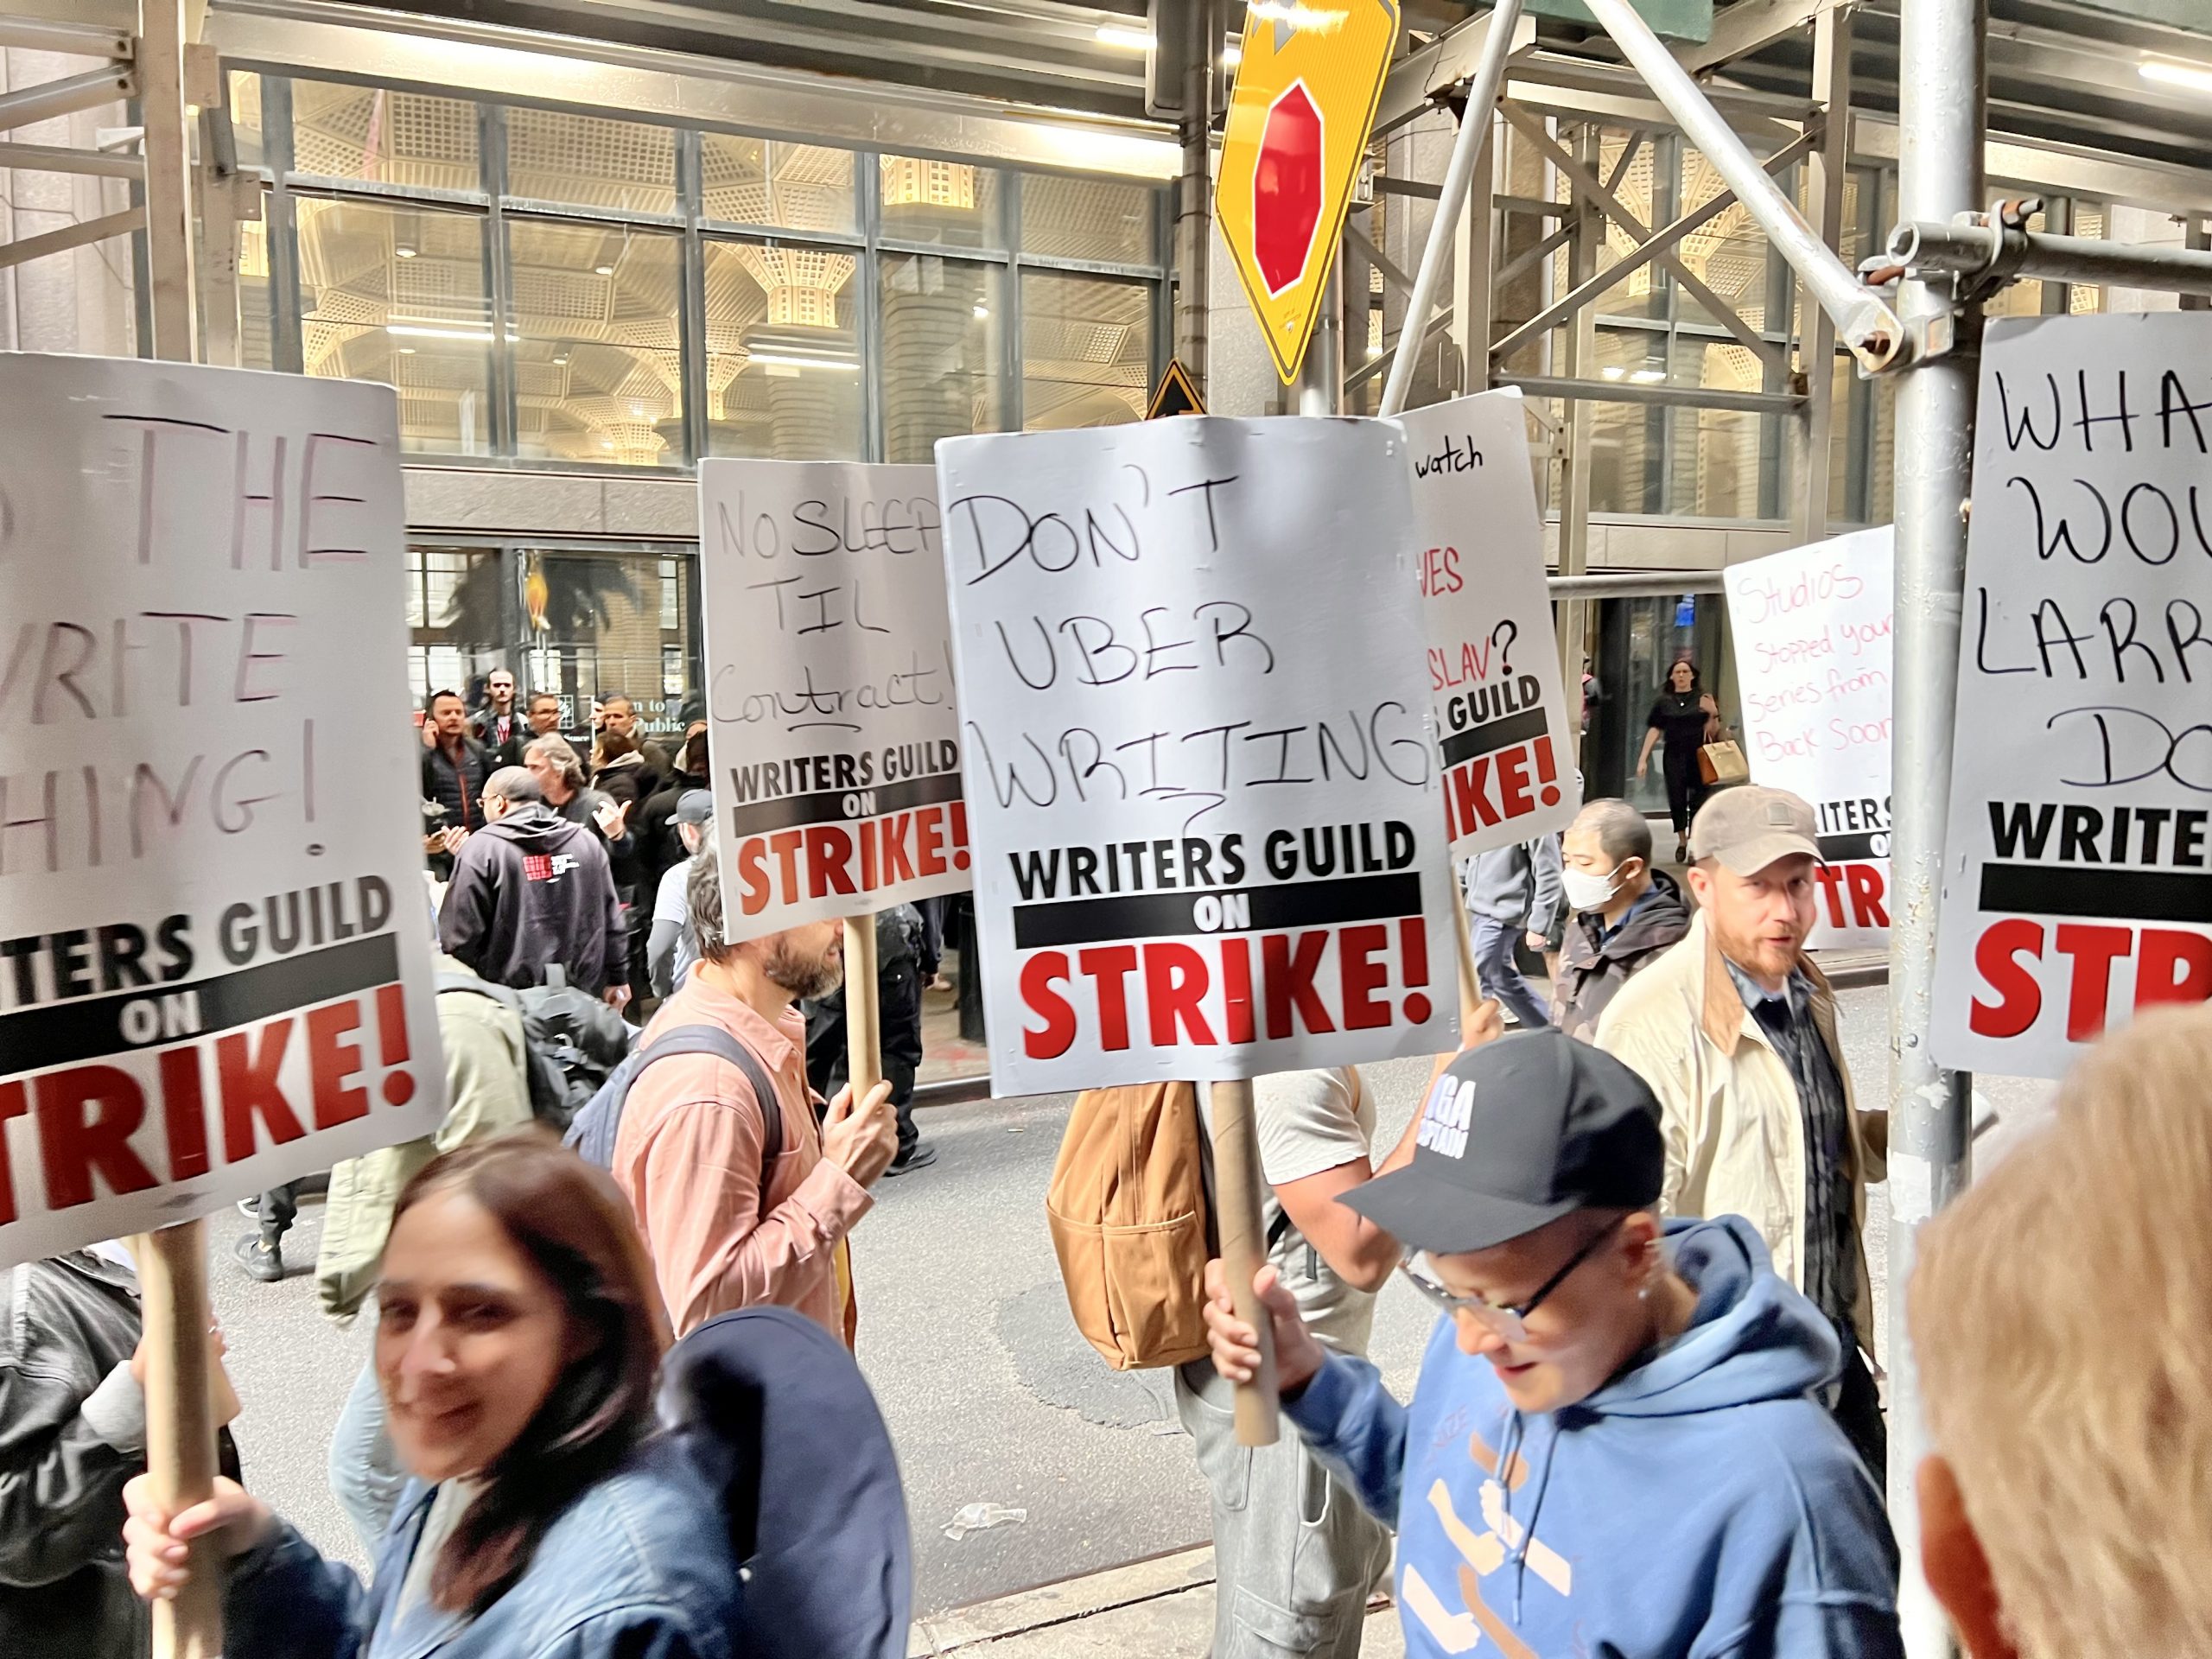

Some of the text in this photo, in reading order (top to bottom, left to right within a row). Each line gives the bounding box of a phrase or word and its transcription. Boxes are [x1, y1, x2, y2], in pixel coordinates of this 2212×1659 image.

[1415, 435, 1483, 478] watch
[102, 415, 378, 571] THE
[717, 489, 941, 559] NO SLEEP
[948, 463, 1238, 585] DON'T
[745, 575, 891, 636] TIL
[1737, 564, 1864, 624] Studios
[994, 601, 1274, 690] UBER
[1977, 587, 2212, 683] LARR
[633, 716, 685, 733] Public
[649, 699, 666, 712] to
[1448, 675, 1541, 731] GUILD
[730, 739, 958, 803] WRITERS GUILD
[963, 701, 1432, 809] WRITING
[842, 791, 877, 817] ON
[1986, 800, 2209, 868] WRITE
[738, 801, 971, 916] STRIKE!
[1007, 820, 1416, 900] WRITERS GUILD
[0, 875, 392, 1007] TERS GUILD
[1193, 893, 1251, 932] ON
[119, 990, 203, 1045] ON
[1020, 917, 1433, 1059] STRIKE!
